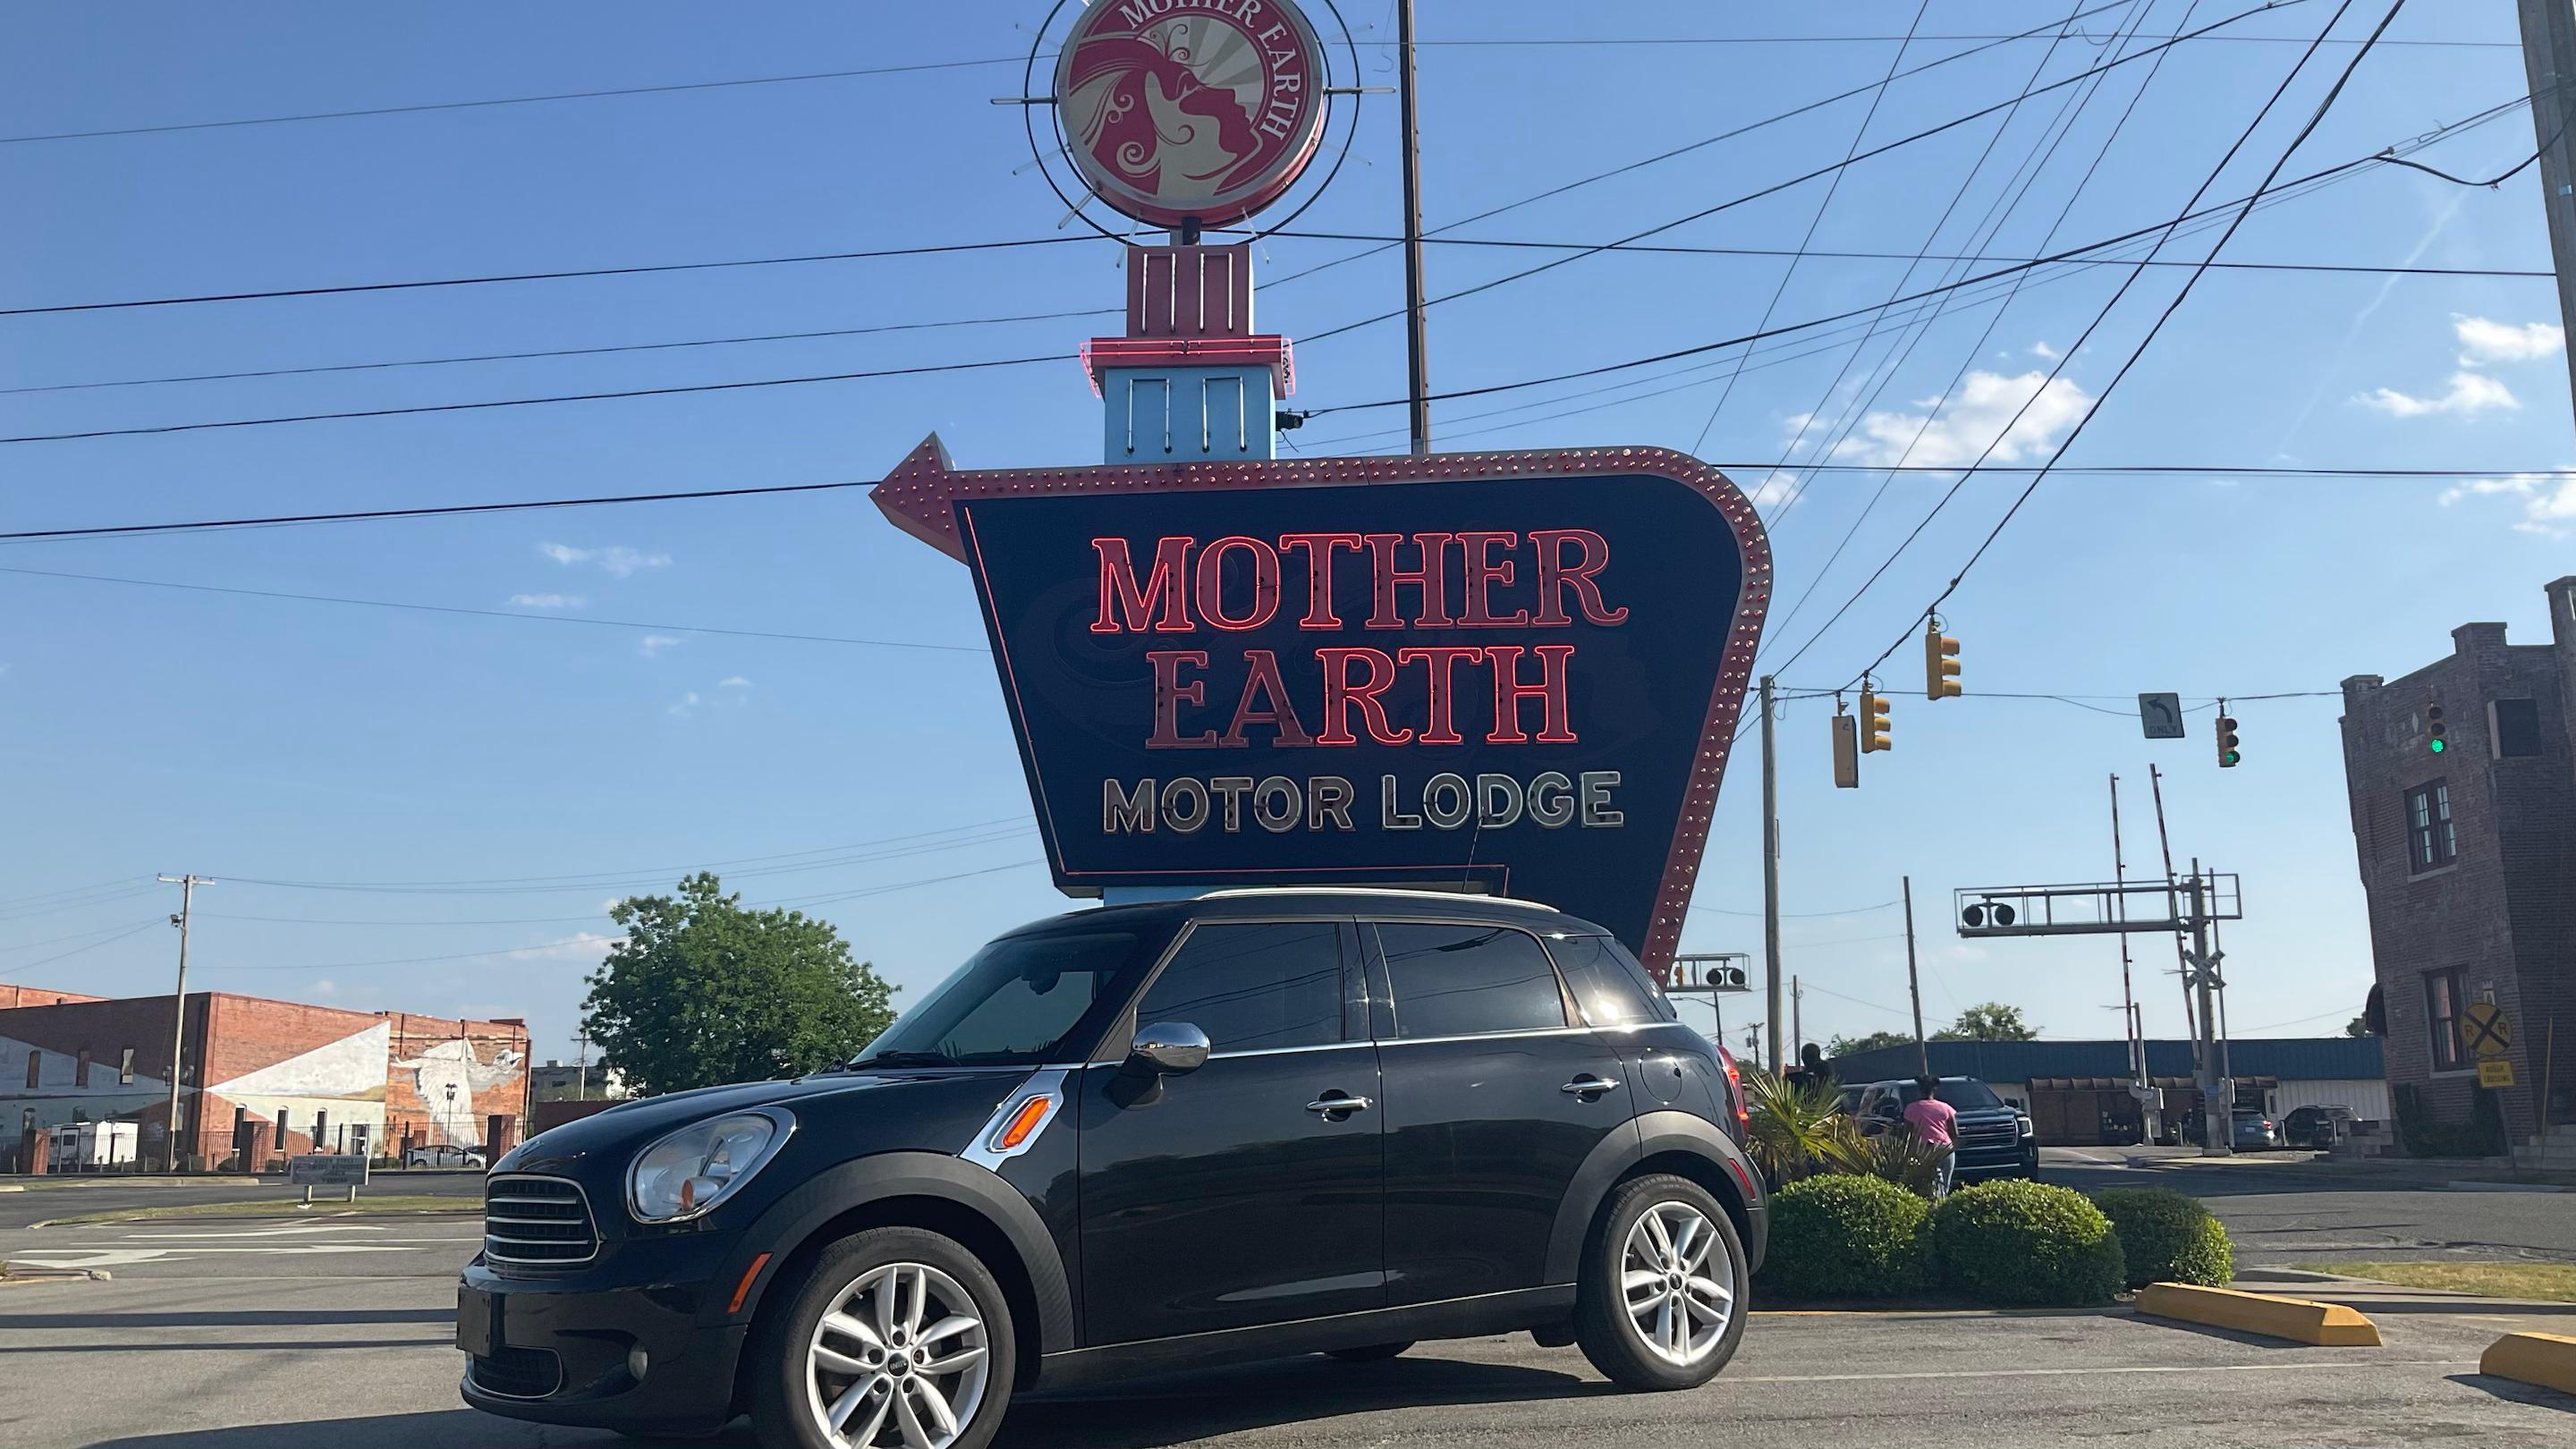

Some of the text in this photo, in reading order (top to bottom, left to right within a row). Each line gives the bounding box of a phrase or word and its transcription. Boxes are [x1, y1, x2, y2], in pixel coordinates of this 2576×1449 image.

[1119, 0, 1301, 140] MOER EARTH
[1090, 529, 1630, 633] MOTHER
[1145, 645, 1579, 749] EARTH
[2148, 724, 2179, 734] ONLY
[1103, 771, 1624, 836] MOTOR LODGE
[2463, 1021, 2509, 1038] R R
